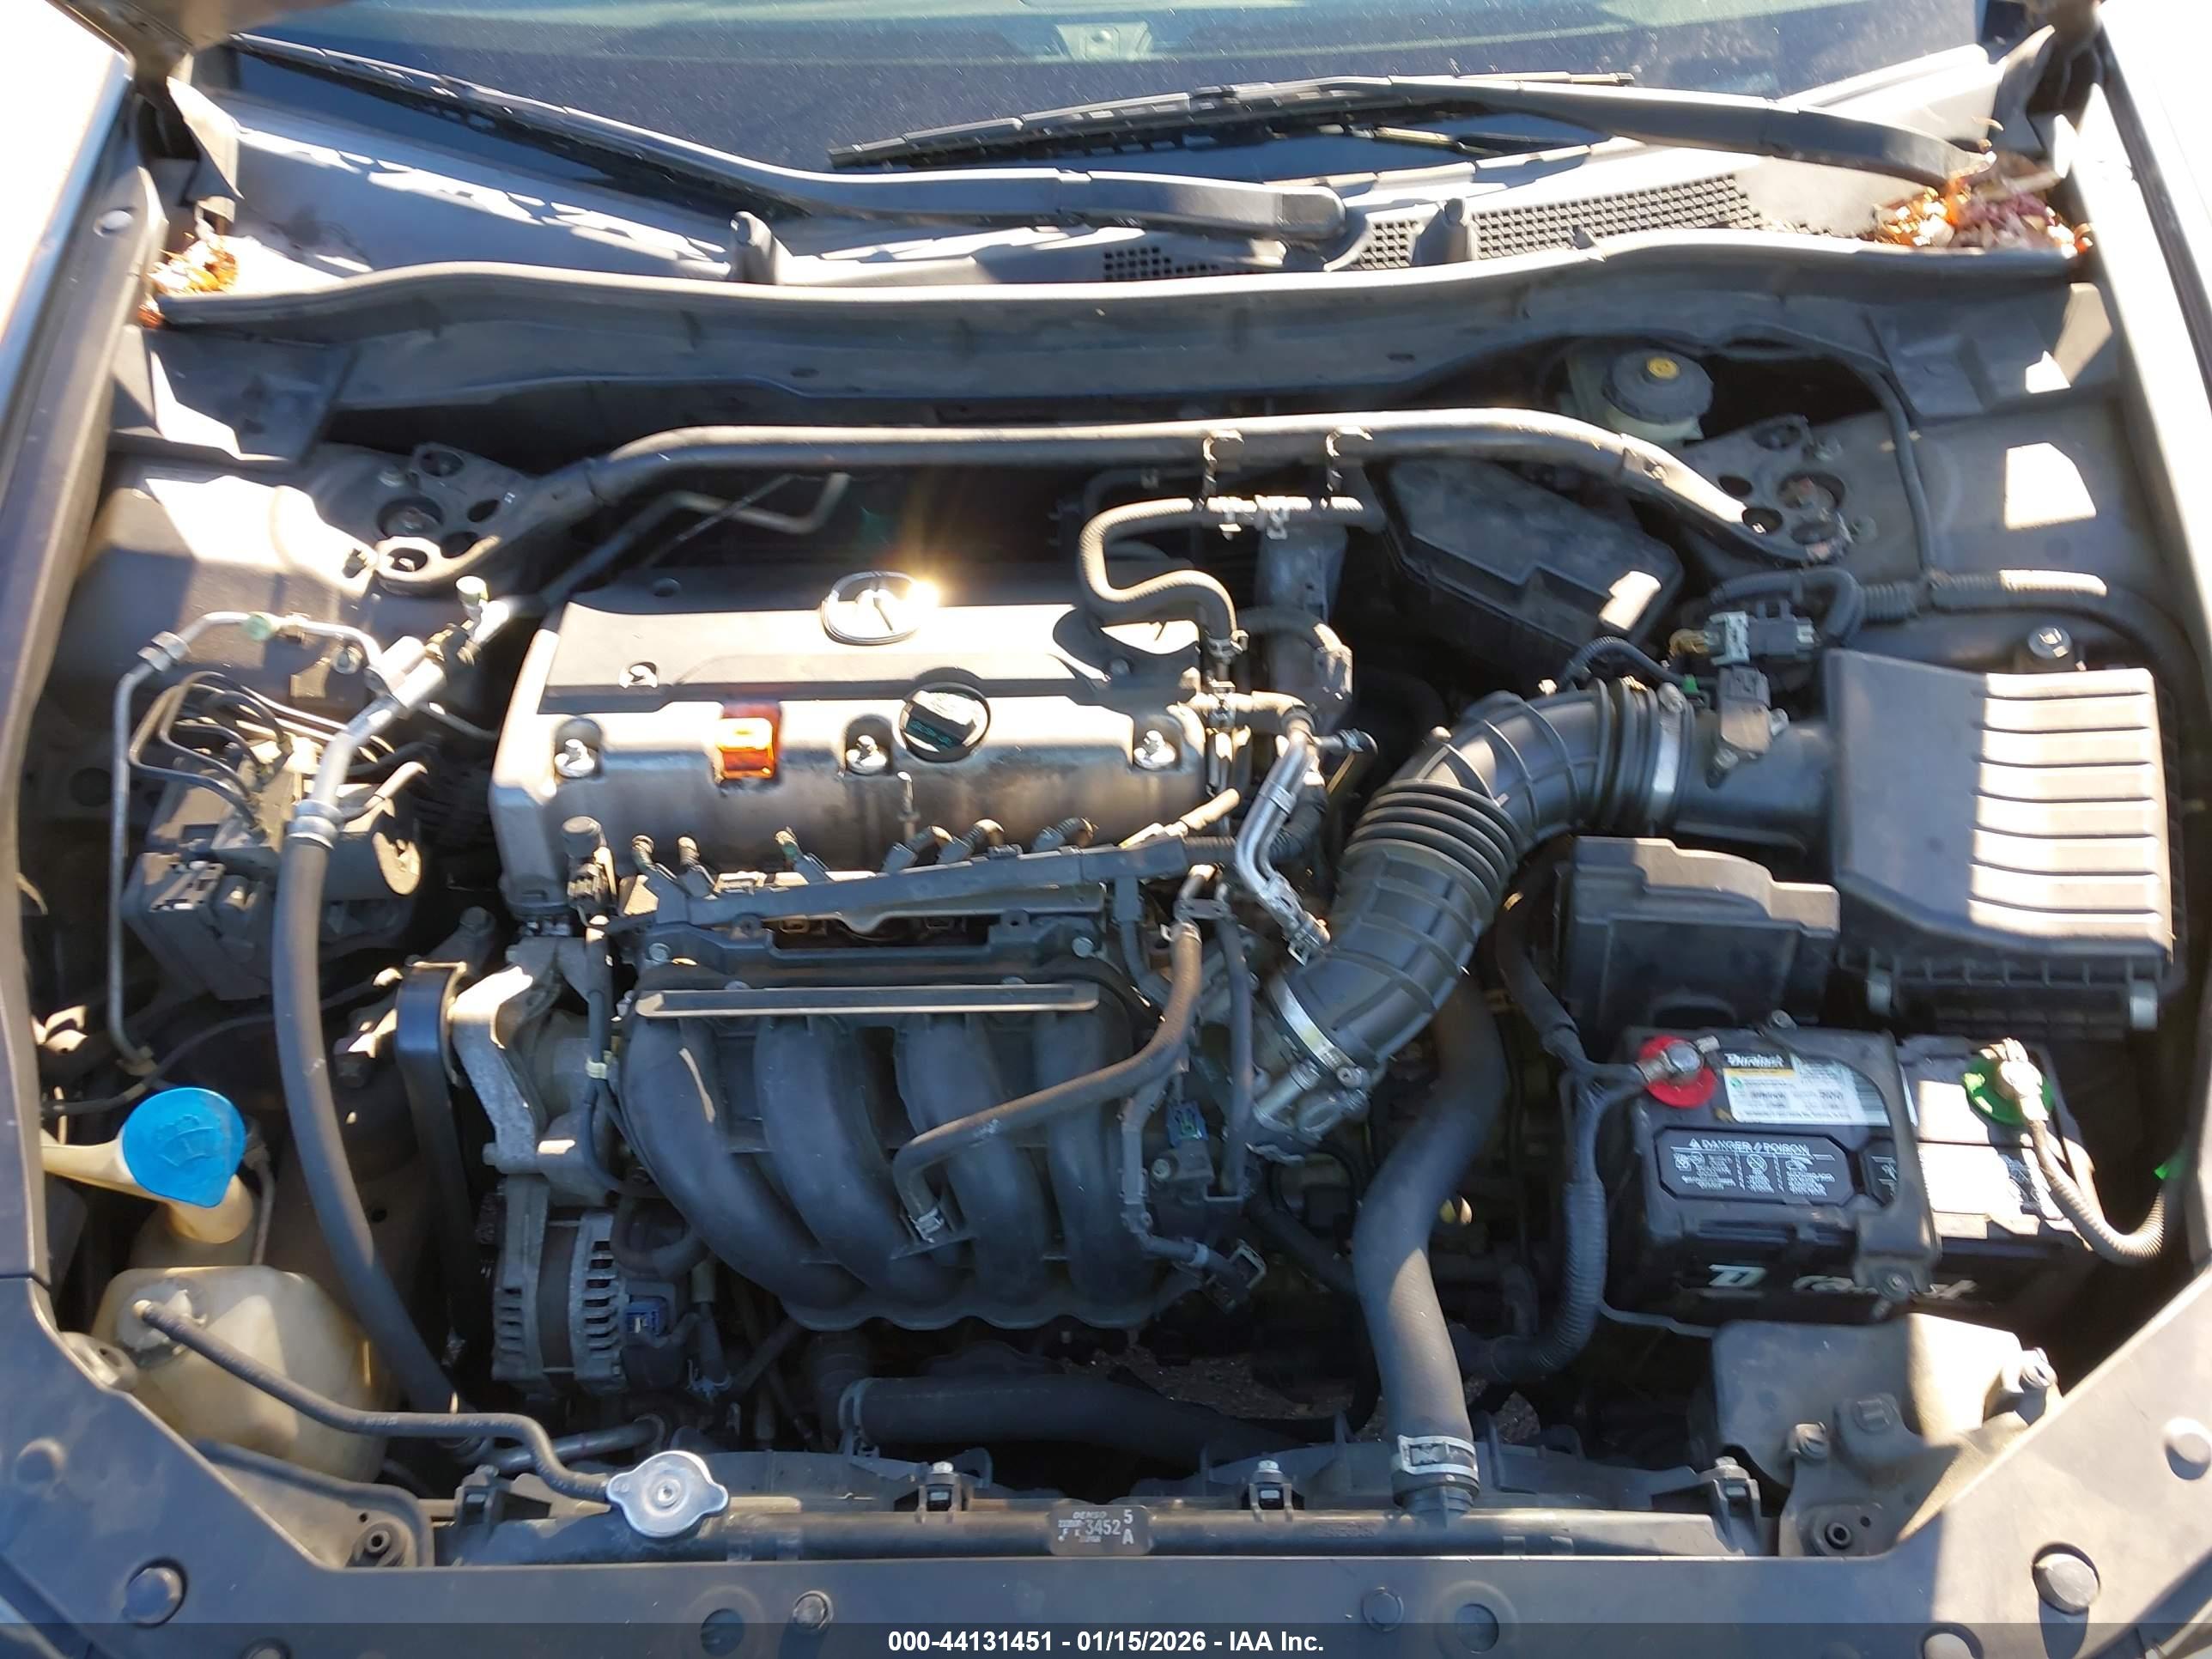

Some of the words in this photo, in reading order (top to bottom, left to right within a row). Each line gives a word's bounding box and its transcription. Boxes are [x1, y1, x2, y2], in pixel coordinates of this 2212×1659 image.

[1701, 1139, 1753, 1152] DANGER
[1764, 1141, 1810, 1156] POISON
[1123, 1508, 1133, 1524] 5
[1085, 1519, 1121, 1535] 3452
[1121, 1528, 1134, 1545] A
